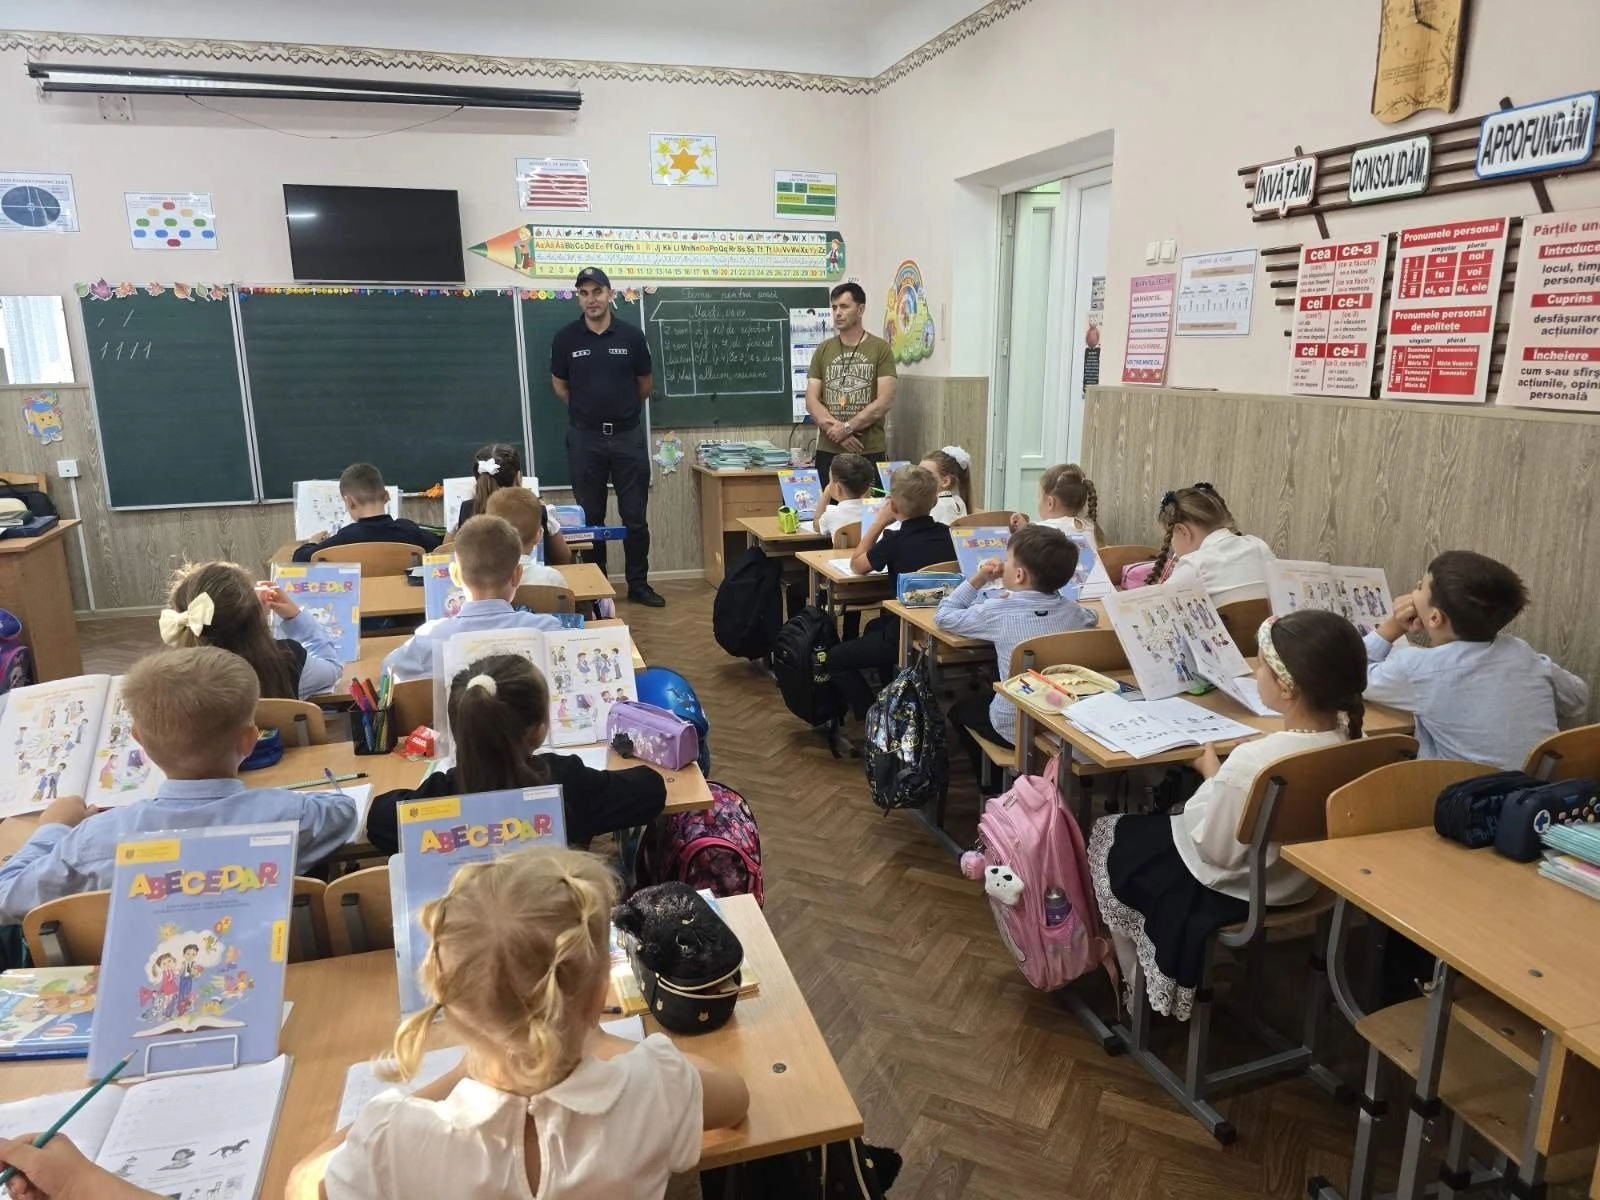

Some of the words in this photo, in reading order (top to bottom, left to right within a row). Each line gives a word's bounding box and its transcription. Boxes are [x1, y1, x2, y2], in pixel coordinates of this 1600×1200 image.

[1481, 100, 1591, 166] APROFUNDĂM
[1404, 229, 1451, 242] Pronumele
[1454, 223, 1499, 238] personal
[1533, 222, 1577, 237] Părțile
[614, 243, 623, 252] Gg
[710, 245, 719, 254] Pp
[1310, 248, 1330, 260] cea
[1342, 244, 1372, 256] ce-a
[1468, 251, 1485, 260] noi
[1467, 267, 1482, 276] voi
[1542, 263, 1574, 274] locul,
[1472, 283, 1488, 291] ele
[1307, 297, 1323, 309] cel
[1338, 294, 1364, 308] ce-l
[1547, 294, 1593, 306] Cuprins
[1395, 310, 1440, 320] Pronumele
[1442, 308, 1486, 320] personal
[1411, 323, 1422, 332] de
[1541, 326, 1598, 338] acțiunilor
[1302, 344, 1318, 356] cei
[1333, 344, 1358, 356] ce-i
[1545, 368, 1569, 376] s-au
[1518, 378, 1567, 390] acțiunile,
[1530, 391, 1588, 401] personală
[284, 580, 353, 594] ABECEDAR
[420, 814, 552, 855] ABECEDAR
[128, 861, 280, 900] ABECEDAR
